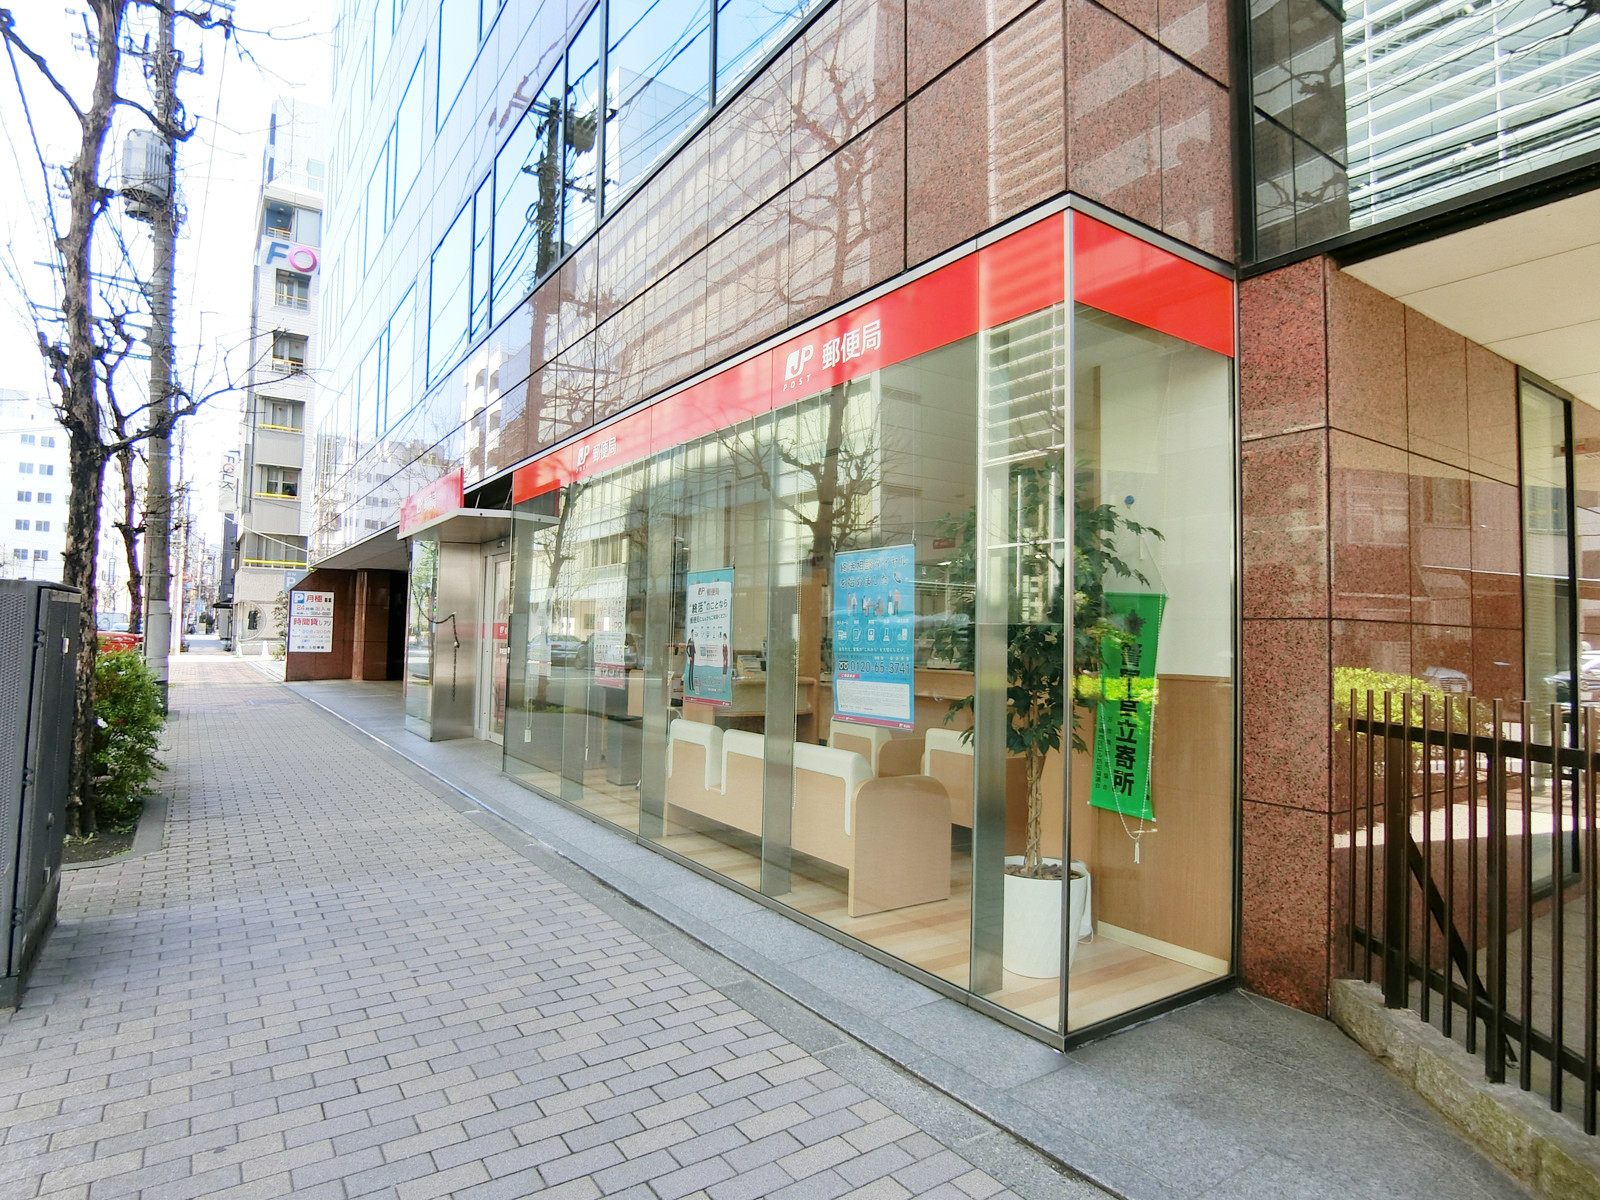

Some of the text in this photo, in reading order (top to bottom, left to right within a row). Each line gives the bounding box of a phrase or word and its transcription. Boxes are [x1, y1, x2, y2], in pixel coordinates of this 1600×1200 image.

[266, 241, 320, 275] FO
[821, 319, 881, 371] 郵便局
[783, 374, 812, 392] POST
[221, 454, 235, 491] FOLK
[286, 577, 296, 587] P
[294, 593, 304, 603] P
[850, 661, 910, 674] 0120-65-3741
